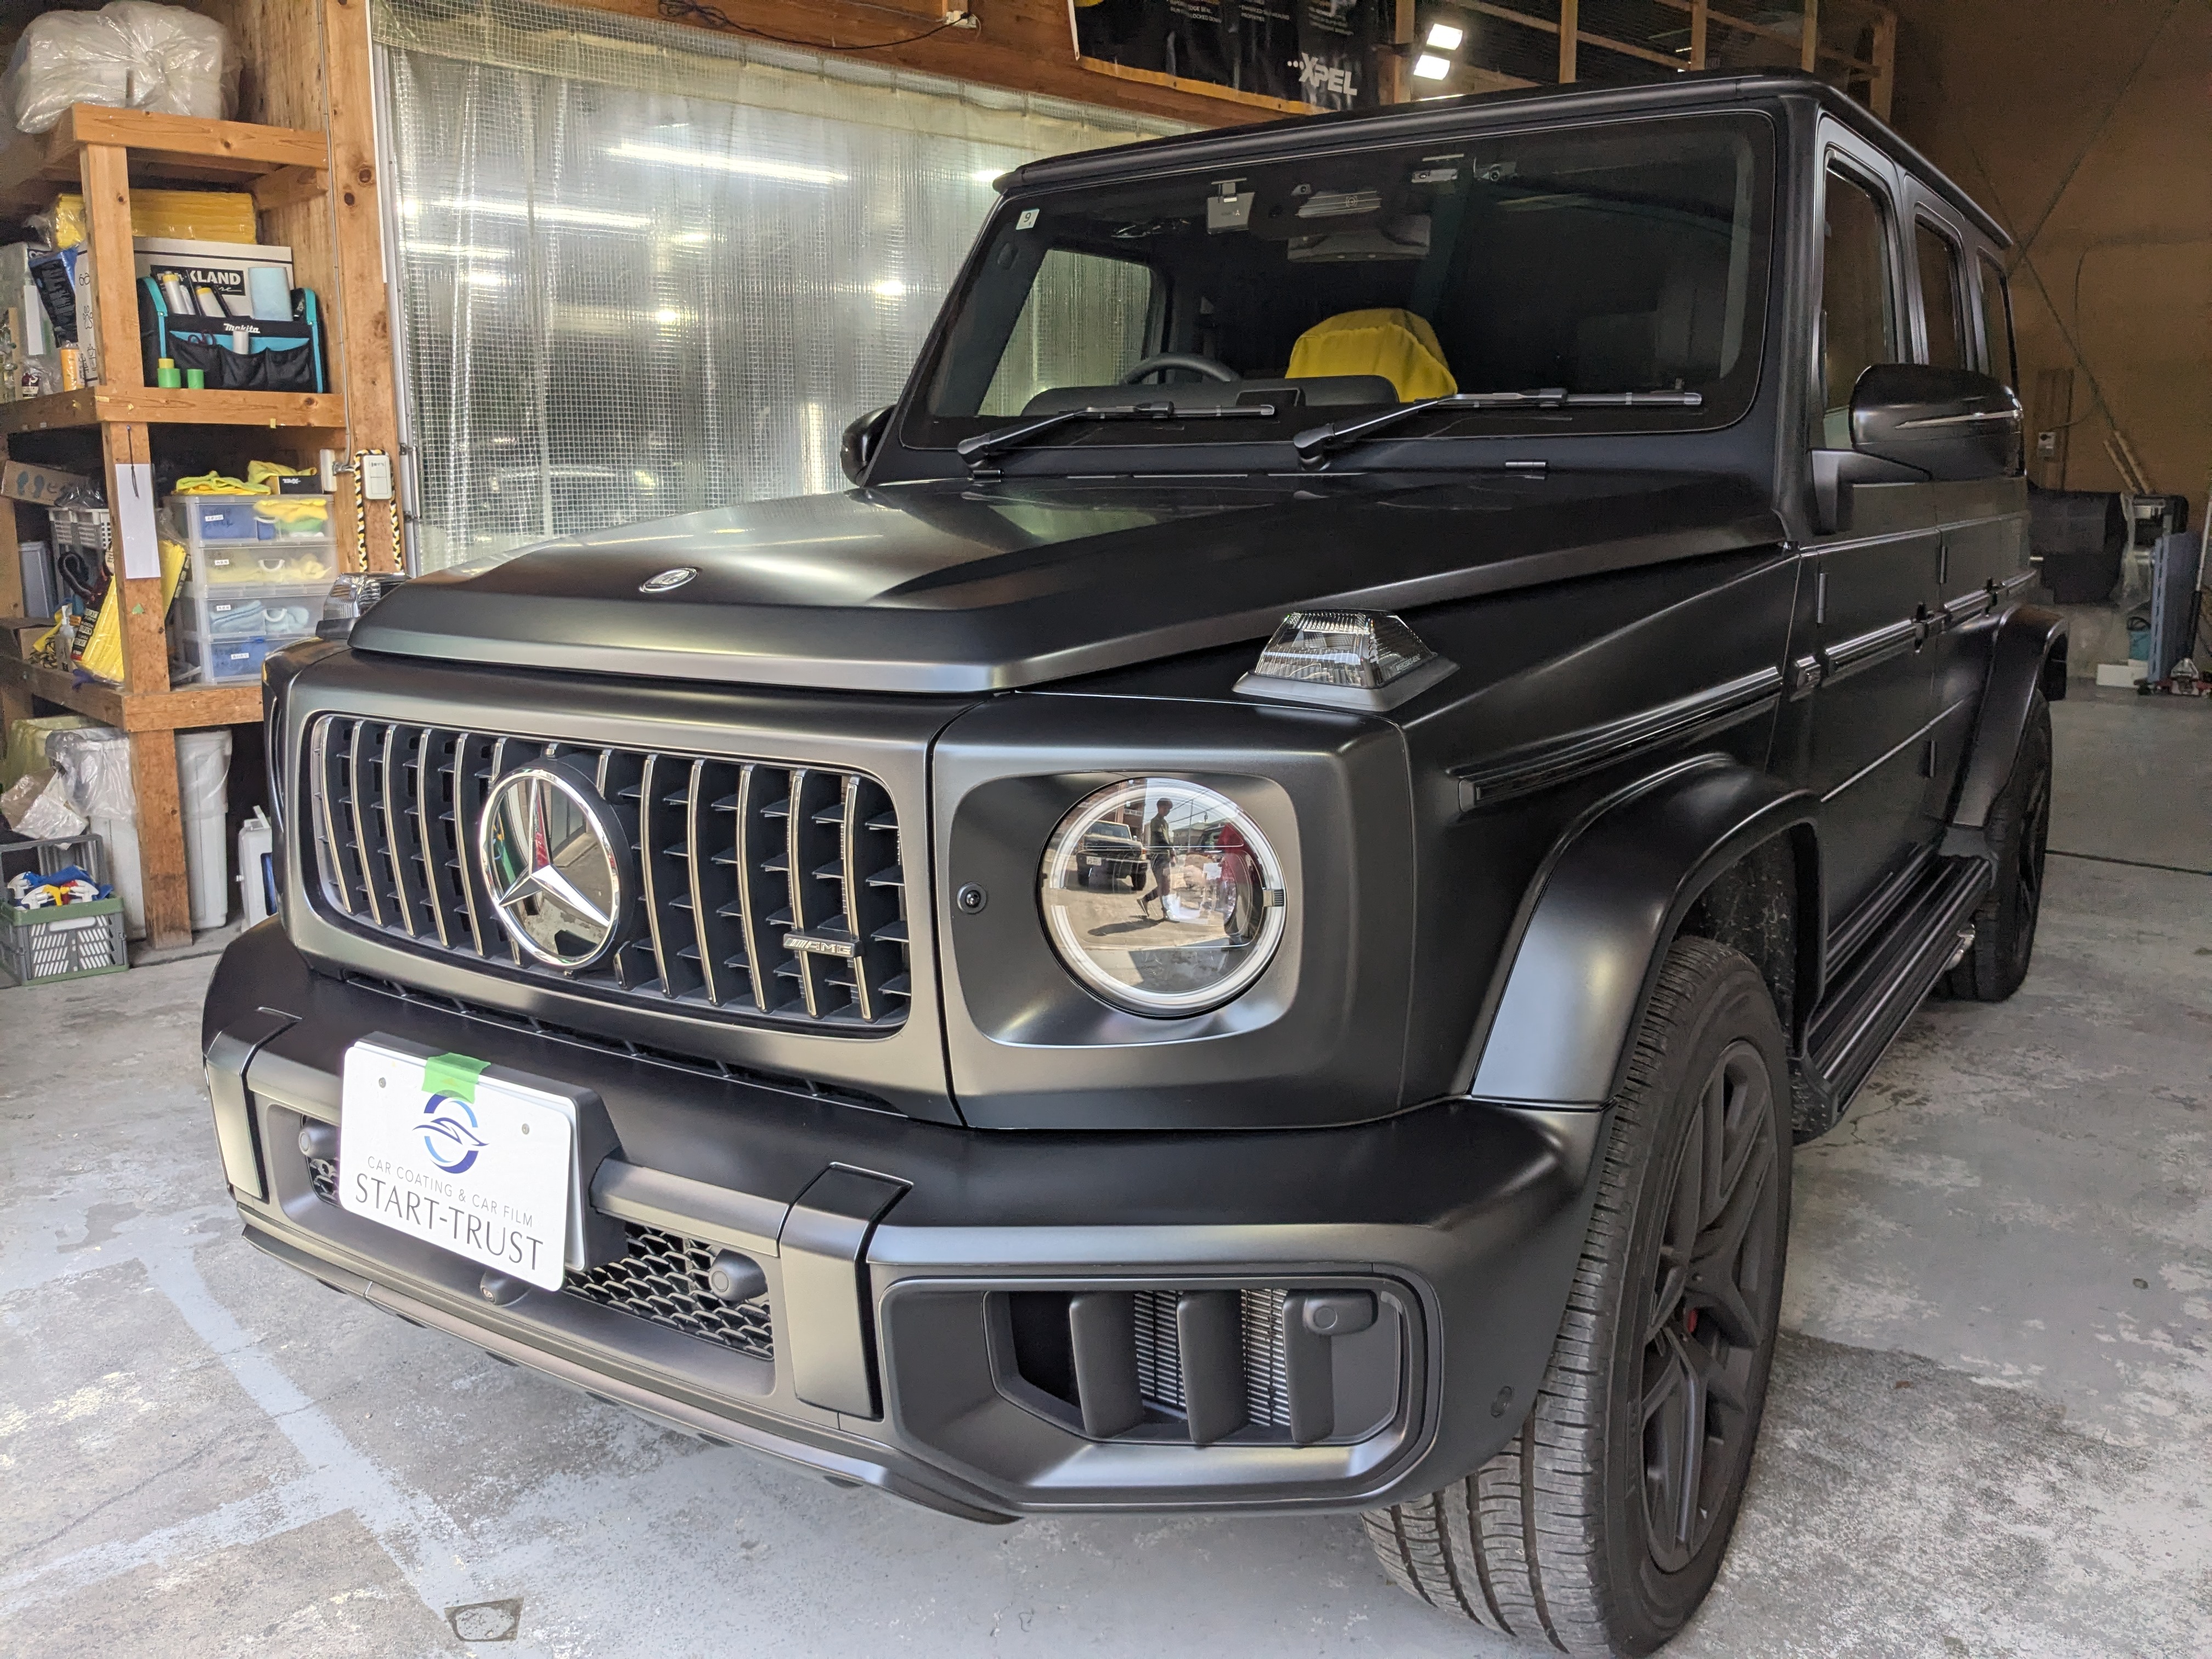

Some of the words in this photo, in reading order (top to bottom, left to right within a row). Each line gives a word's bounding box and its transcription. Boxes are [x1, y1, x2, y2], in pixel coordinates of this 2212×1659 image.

[1298, 52, 1357, 96] XPEL
[1024, 212, 1031, 223] 9
[804, 940, 851, 955] AMG
[368, 1156, 391, 1175] CAR
[397, 1166, 453, 1197] COATING
[459, 1188, 466, 1203] &
[472, 1194, 498, 1215] CAR
[504, 1205, 533, 1228] FILM
[356, 1173, 544, 1271] START-TRUST
